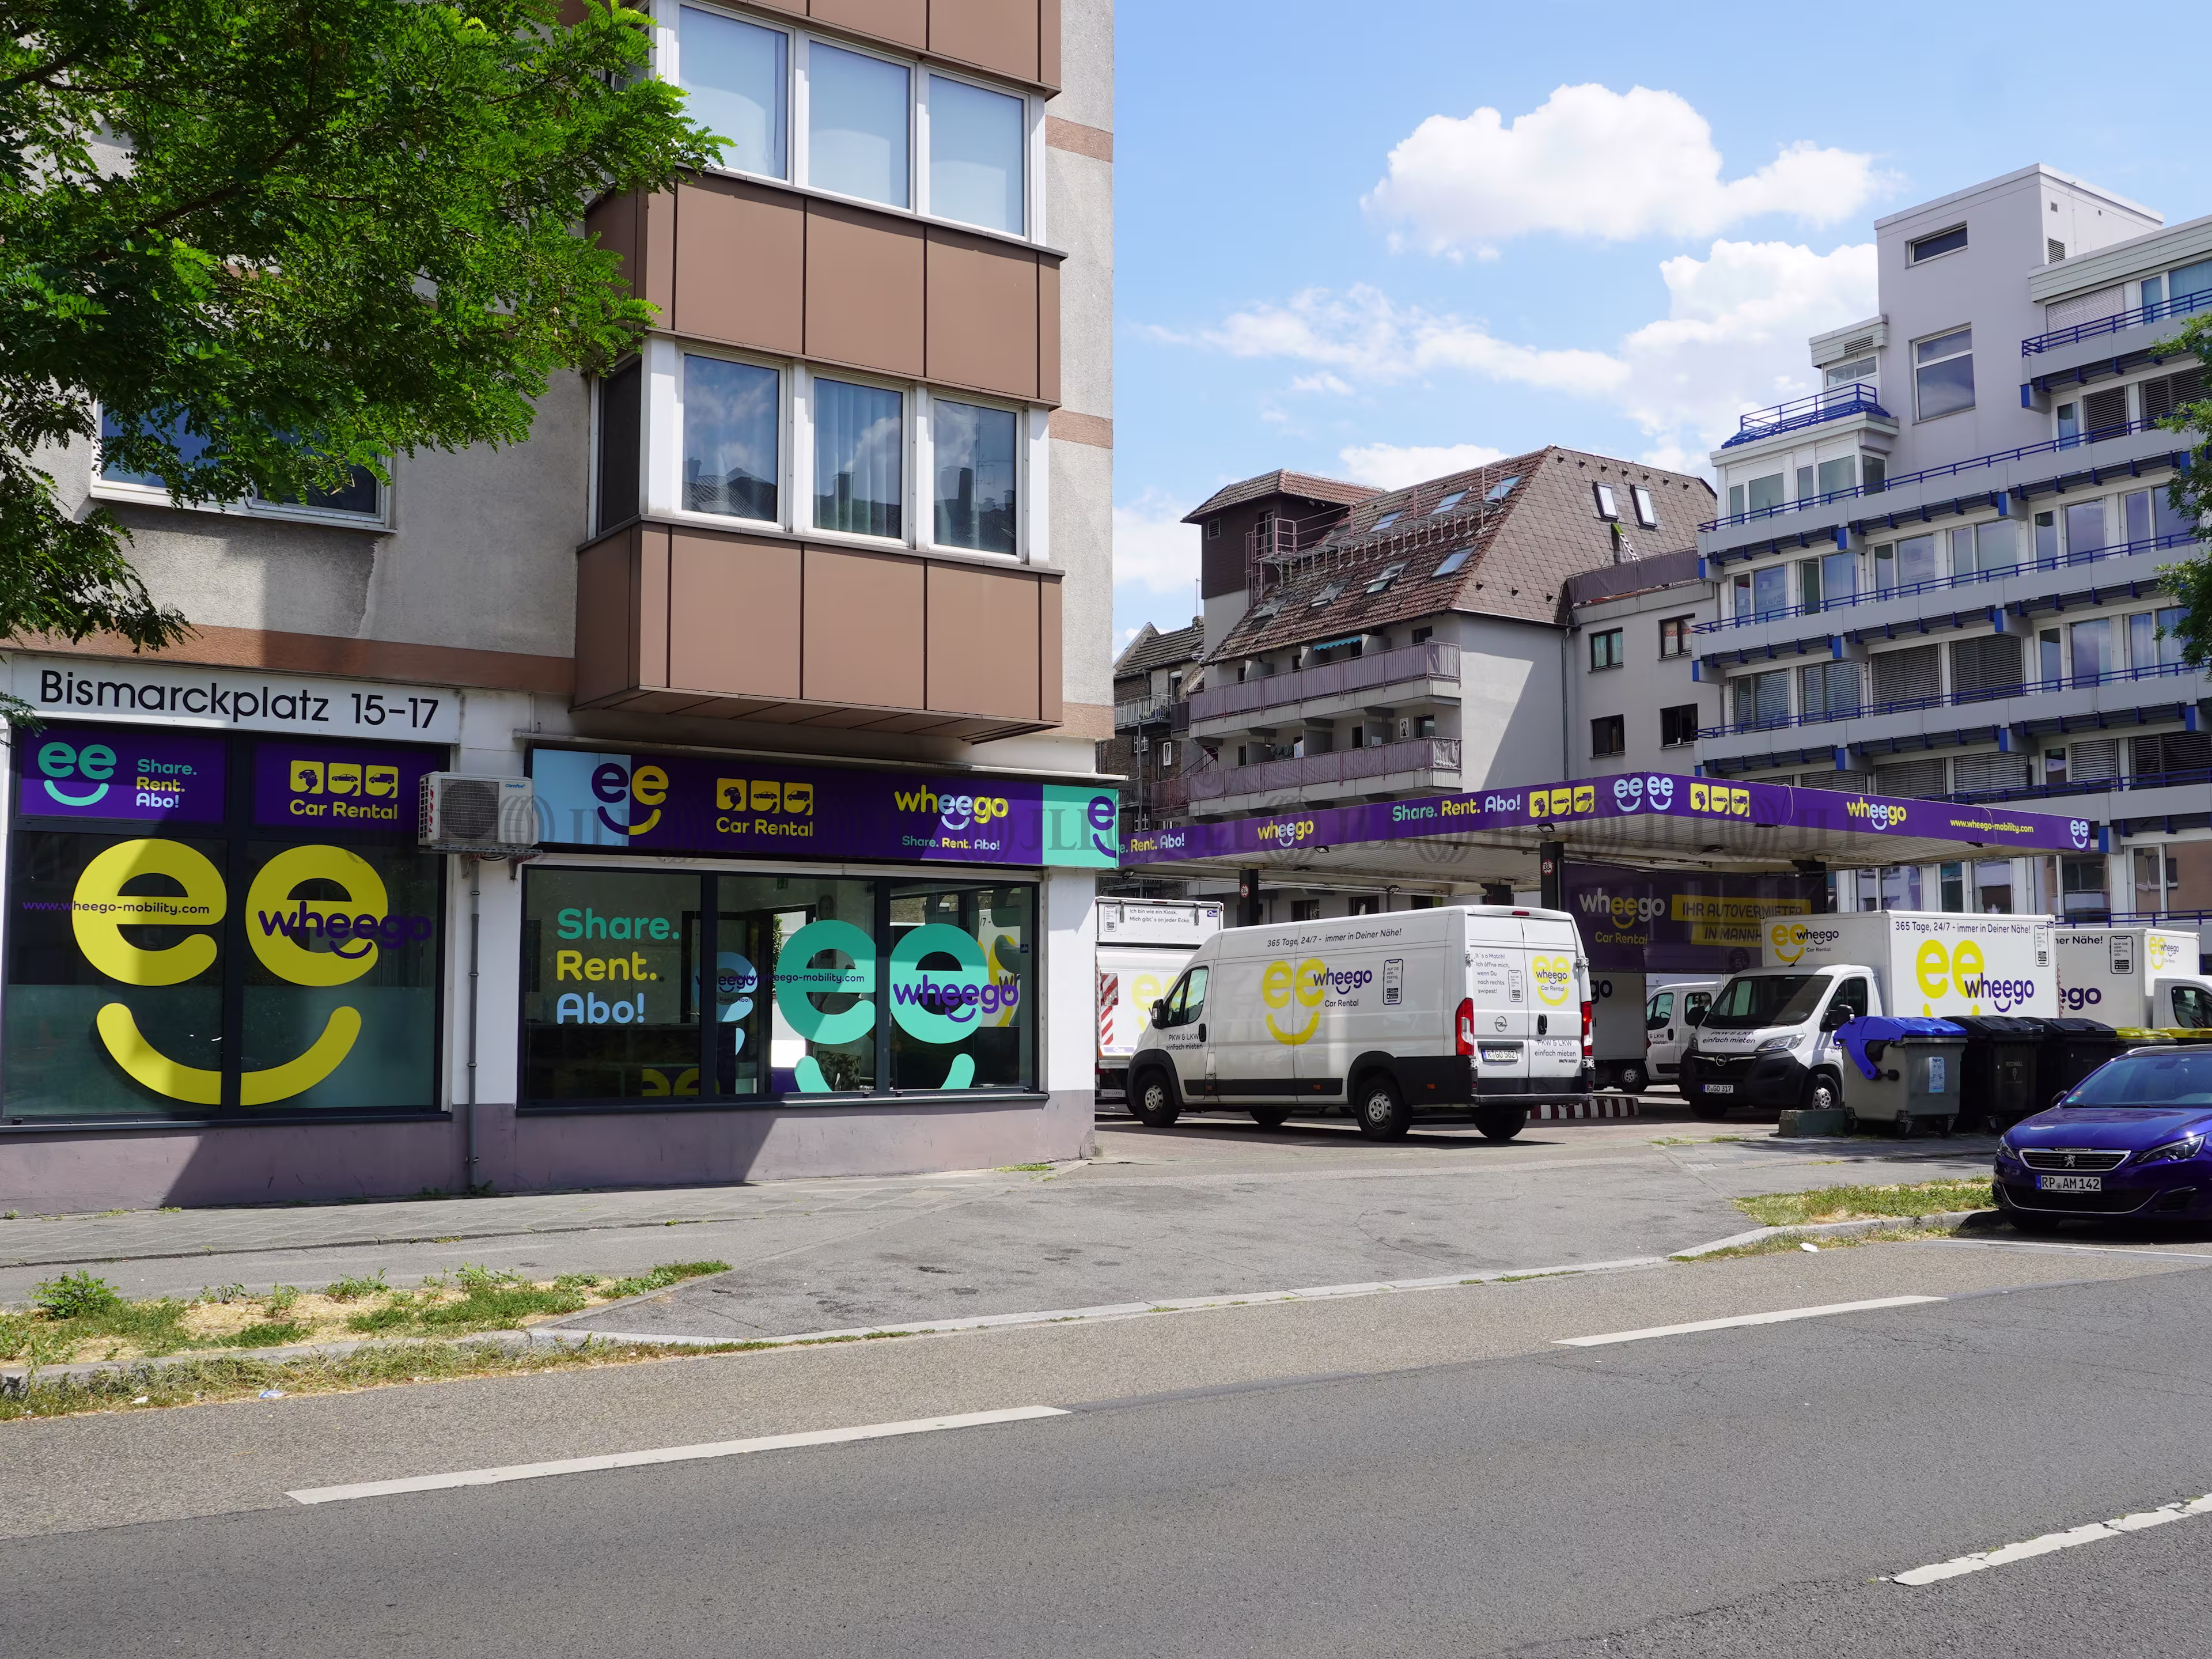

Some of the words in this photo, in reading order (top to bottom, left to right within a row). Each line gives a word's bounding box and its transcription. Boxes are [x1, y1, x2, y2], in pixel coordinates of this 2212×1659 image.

[40, 671, 329, 723] Bismarckplatz
[351, 693, 439, 728] 15-17
[137, 758, 198, 776] Share.
[136, 777, 185, 792] Rent.
[136, 792, 179, 808] Abo!
[895, 785, 1008, 823] wheego
[1392, 805, 1437, 822] Share.
[1441, 800, 1480, 816] Rent.
[1485, 794, 1520, 813] Abo!
[289, 800, 327, 817] Car
[332, 801, 397, 820] Rental
[1847, 796, 1906, 826] wheego
[717, 817, 749, 834] Car
[755, 819, 813, 837] Rental
[1258, 820, 1313, 840] wheego
[1950, 820, 2033, 834] www.wheego-mobility.com
[902, 836, 939, 848] Share.
[942, 838, 971, 849] Rent.
[974, 839, 999, 850] Abo!
[1131, 838, 1157, 852] Rent.
[1160, 833, 1184, 849] Abo!
[22, 900, 209, 915] www.wheego-mobility.com
[1580, 888, 1665, 922] wheego
[1683, 902, 1704, 916] IHR
[1707, 903, 1802, 918] AUTOVERMIETER
[258, 901, 432, 949] wheego
[557, 908, 679, 940] Share.
[1895, 922, 1910, 931] 365
[1912, 922, 1931, 933] Tage,
[1934, 922, 1950, 931] 24/7
[1957, 923, 1978, 933] immer
[1980, 924, 1986, 933] in
[1988, 924, 2009, 933] Deiner
[2011, 924, 2031, 933] Nähe!
[1356, 931, 1378, 939] Deiner
[1380, 928, 1402, 937] Nähe!
[1595, 931, 1613, 943] Car
[1615, 932, 1648, 945] Rental
[1705, 927, 1717, 940] IN
[1720, 927, 1762, 941] MANNH
[1797, 929, 1839, 941] wheego
[2073, 936, 2103, 944] Nähe!
[2160, 942, 2179, 955] wheego
[557, 950, 657, 981] Rent.
[1313, 968, 1372, 988] wheego
[1536, 969, 1567, 982] wheego
[893, 975, 1018, 1013] wheego
[1964, 972, 2035, 1005] wheego
[556, 992, 645, 1024] Abo!
[1338, 999, 1359, 1007] Rental
[2042, 1177, 2055, 1188] RP
[2063, 1177, 2076, 1189] AM
[2079, 1179, 2100, 1190] 142
